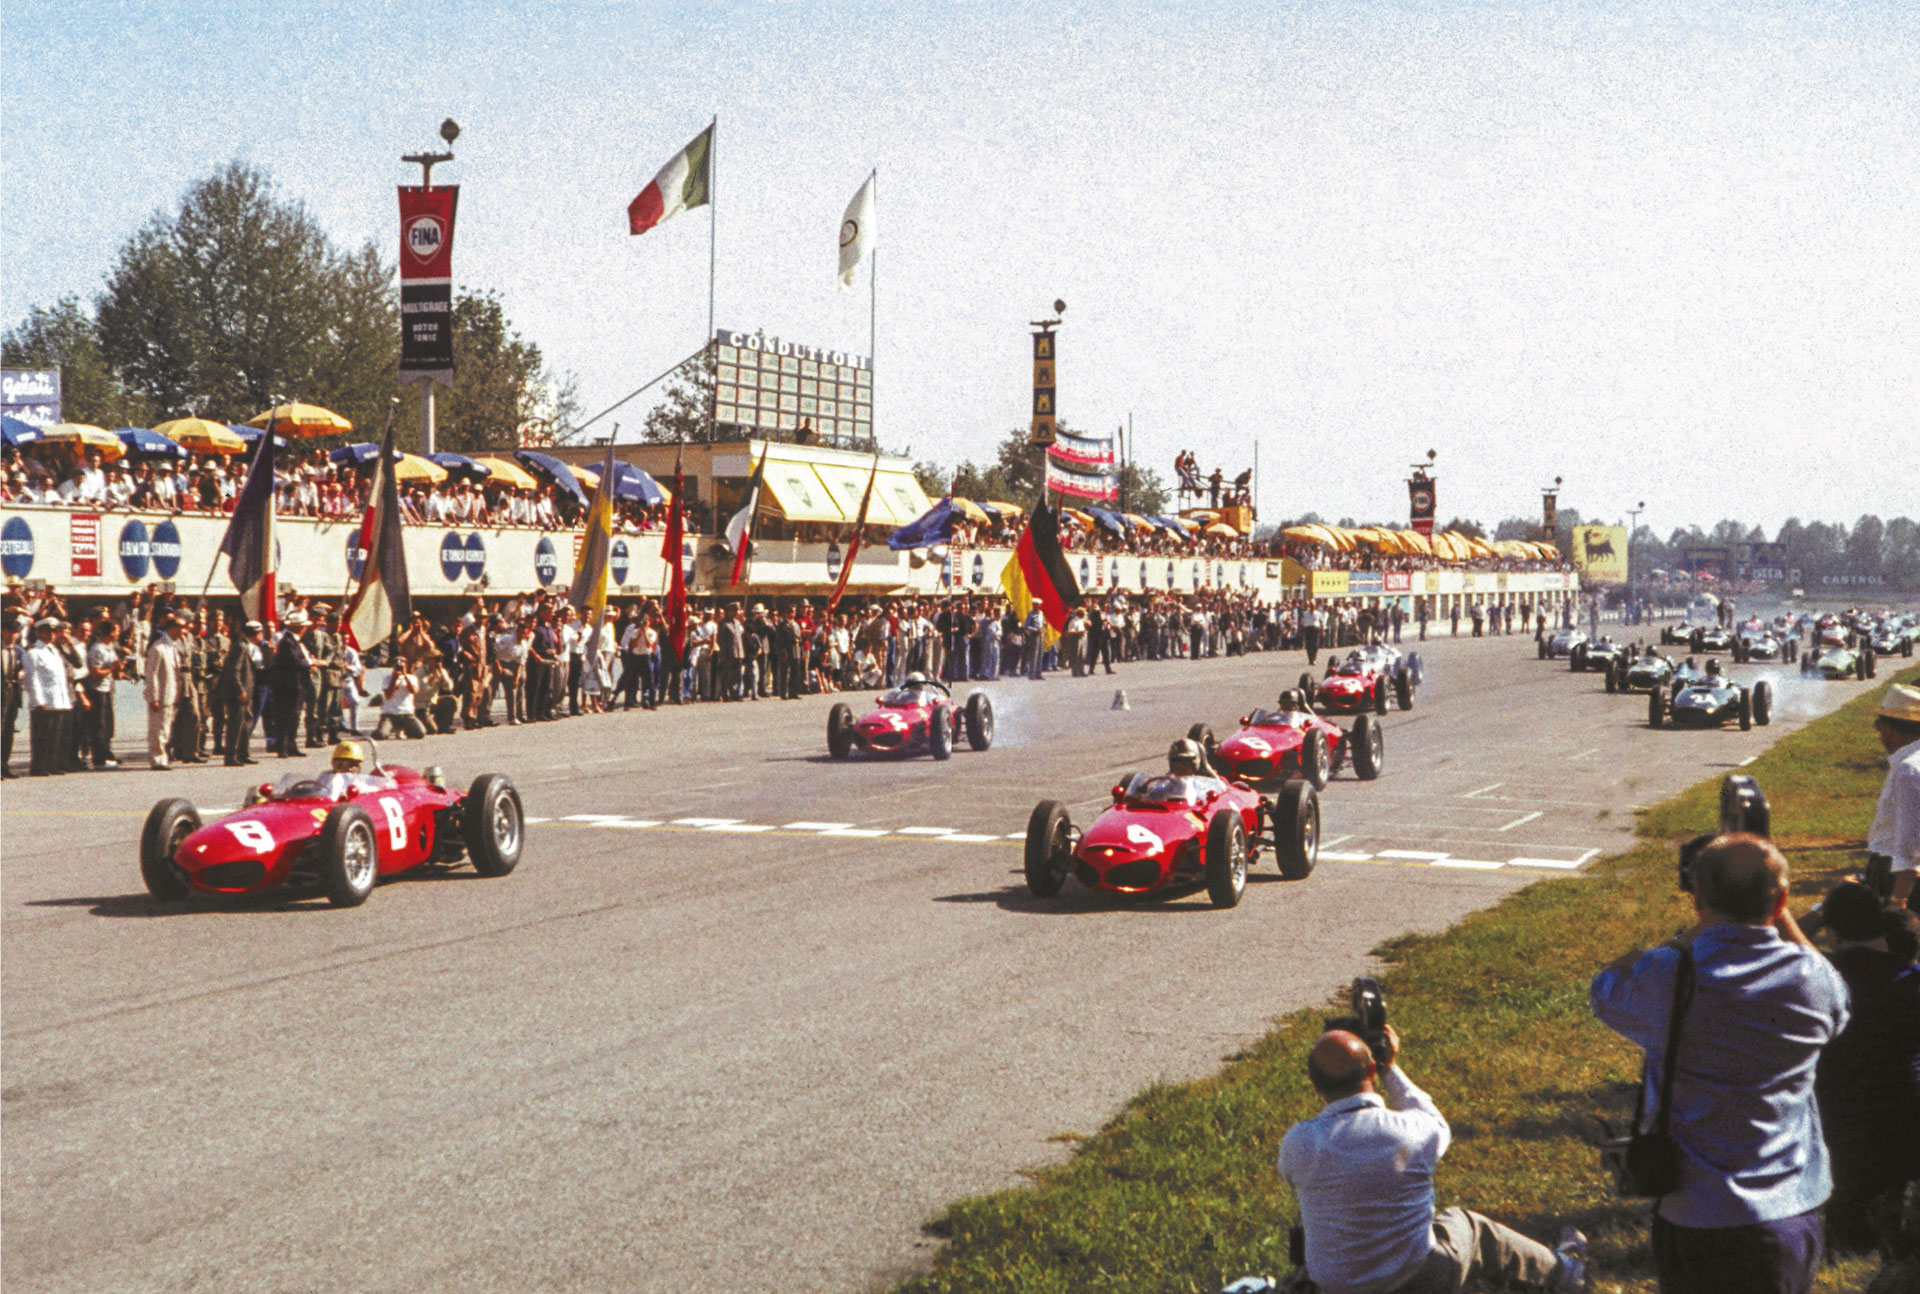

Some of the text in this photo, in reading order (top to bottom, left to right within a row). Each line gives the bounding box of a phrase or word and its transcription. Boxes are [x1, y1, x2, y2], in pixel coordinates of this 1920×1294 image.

[411, 227, 440, 247] FINA
[402, 301, 449, 313] MULTIGRADE
[730, 332, 867, 369] CONDUTTORI
[1822, 575, 1887, 585] CASTROL
[880, 713, 909, 731] 2
[1126, 824, 1165, 853] 4
